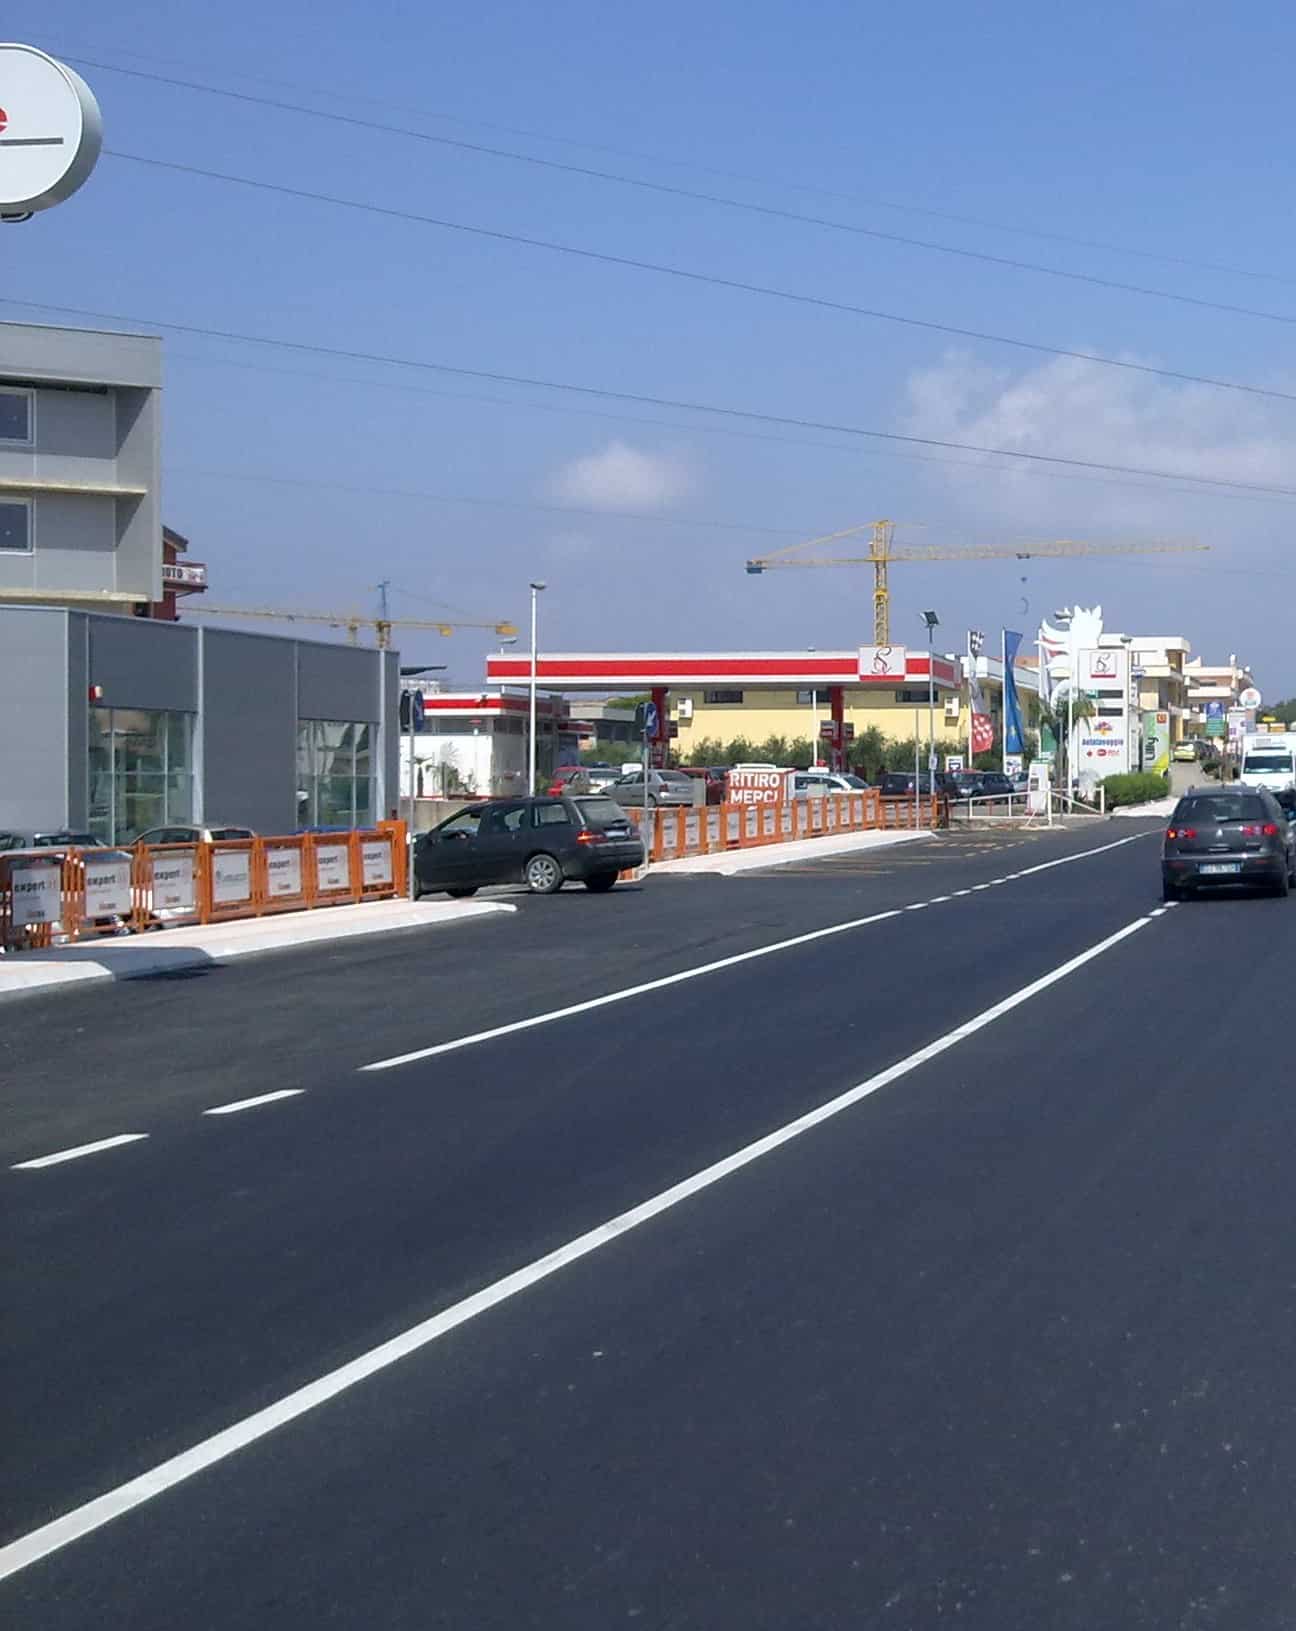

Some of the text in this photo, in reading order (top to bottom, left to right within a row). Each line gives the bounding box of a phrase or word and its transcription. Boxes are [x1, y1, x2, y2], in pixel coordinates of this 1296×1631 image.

[730, 772, 780, 788] RITIRO
[14, 879, 46, 893] expert
[87, 874, 116, 886] expert
